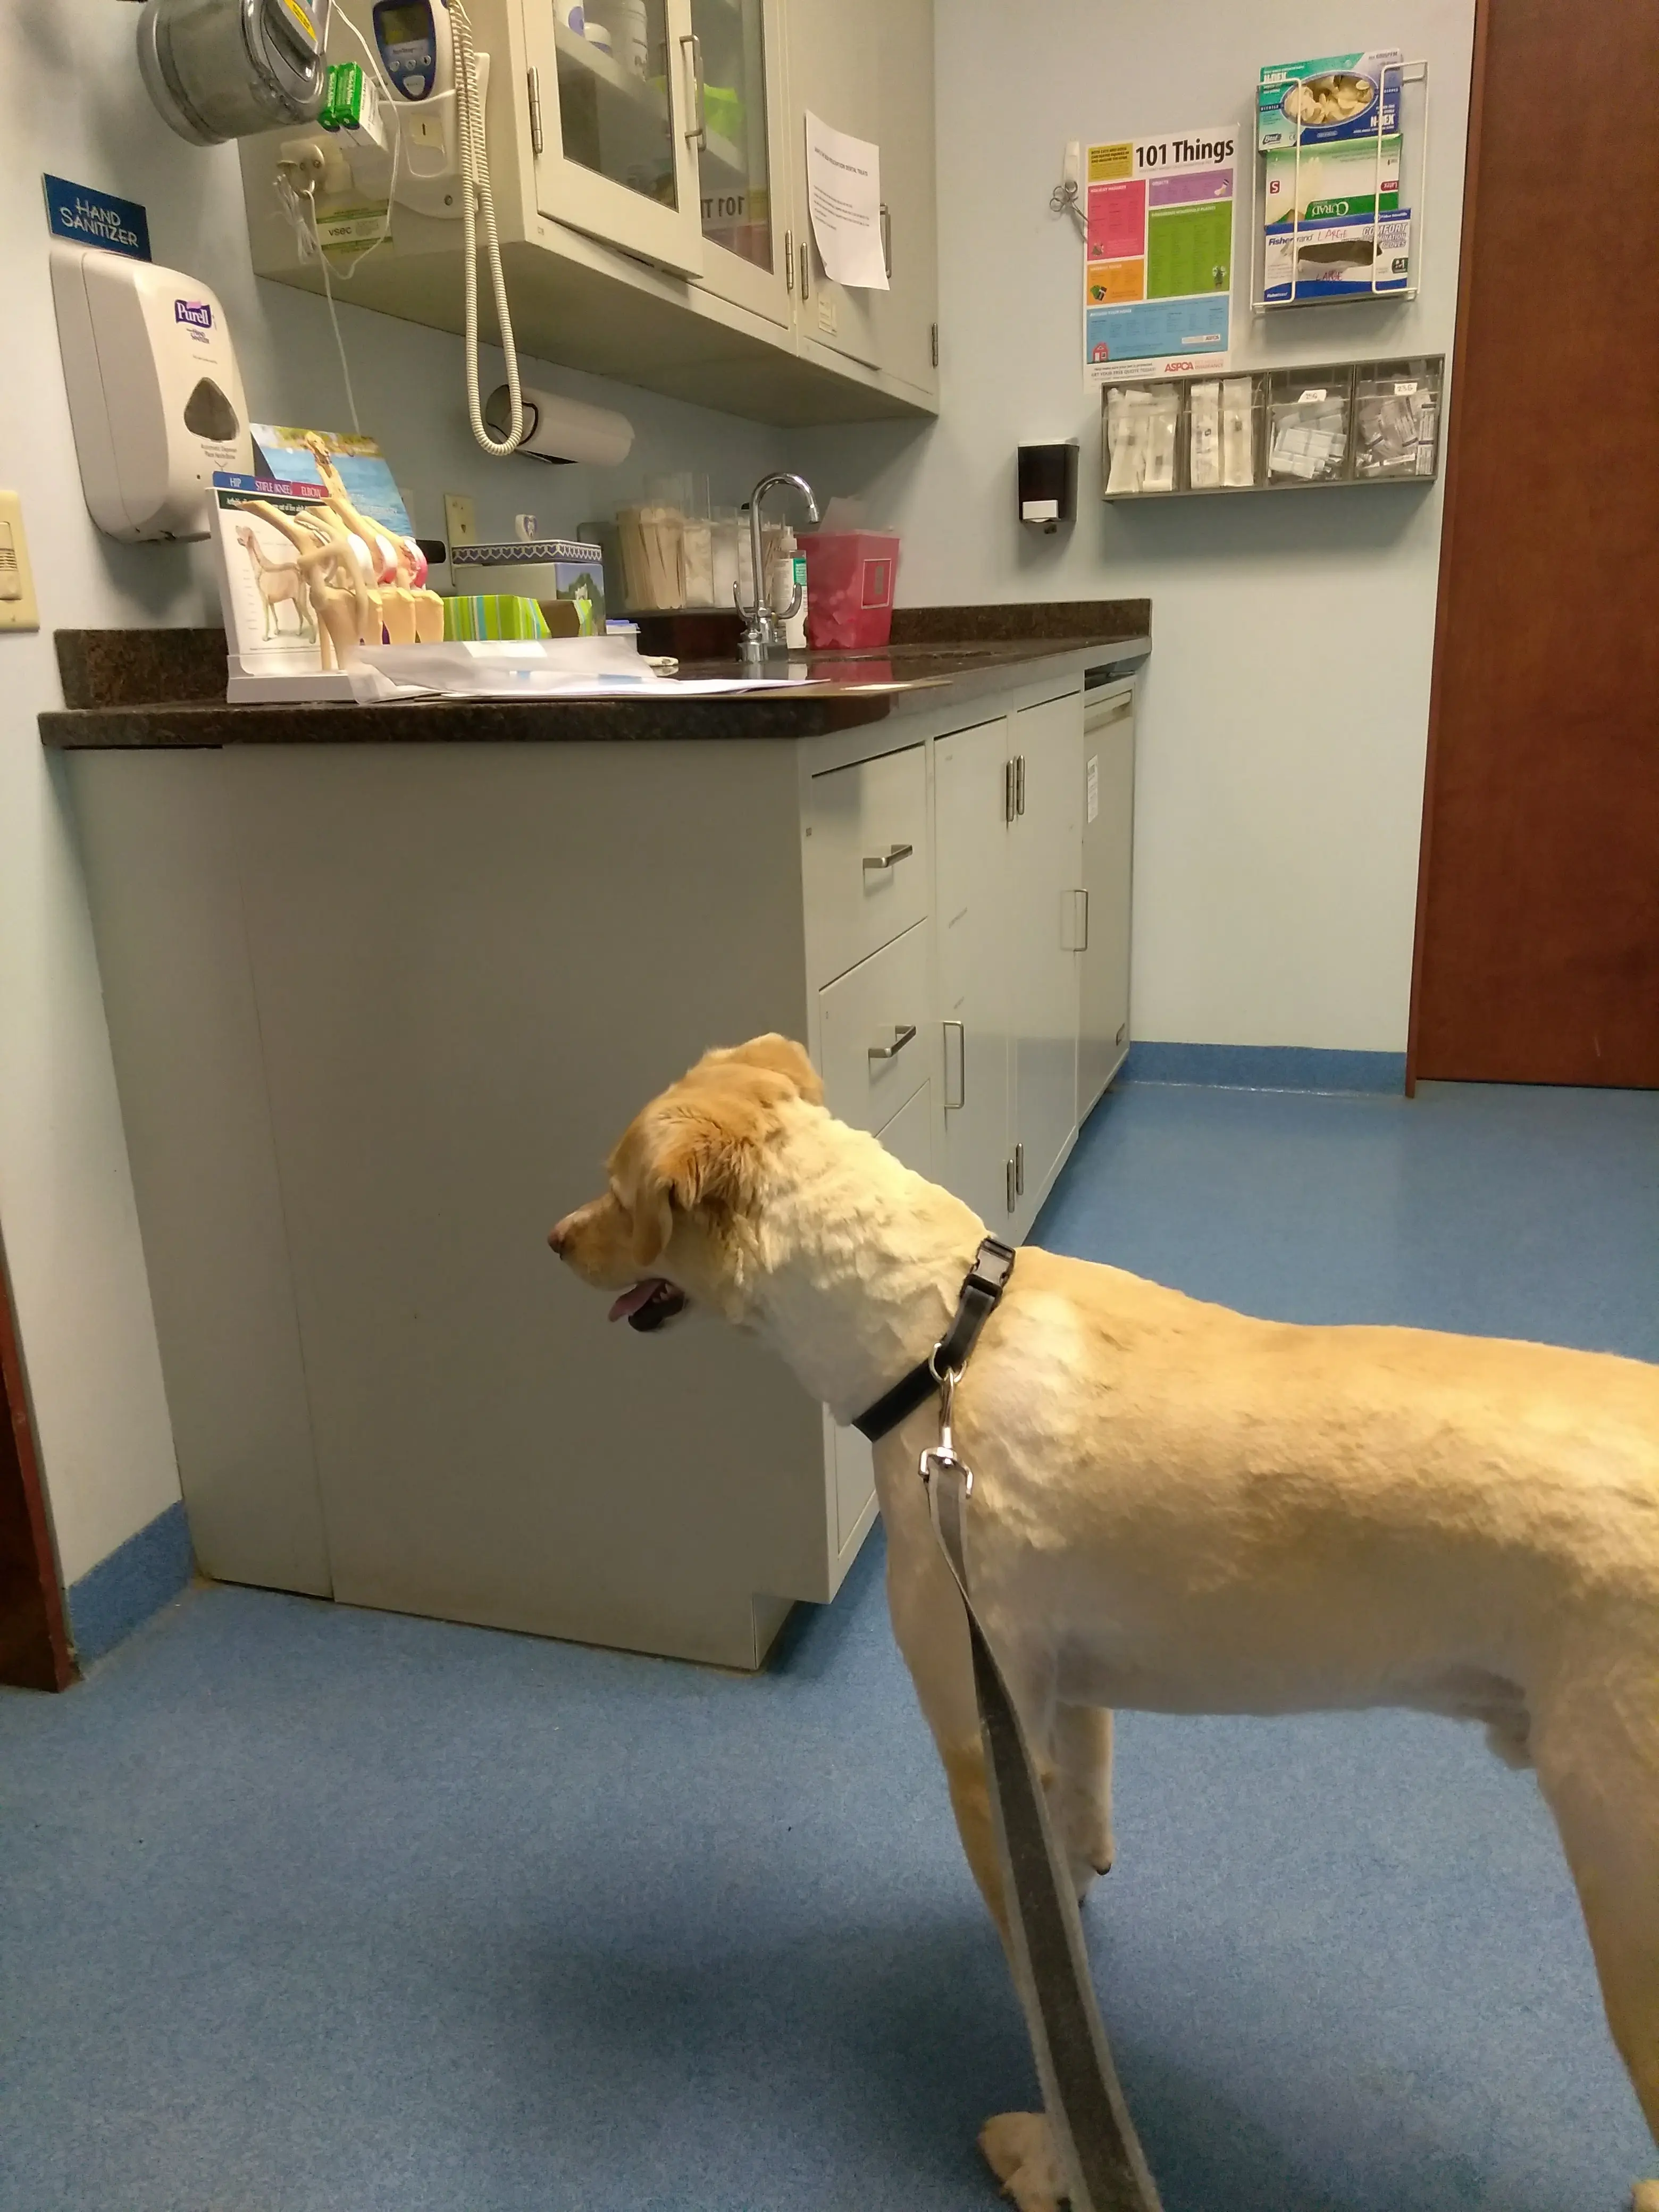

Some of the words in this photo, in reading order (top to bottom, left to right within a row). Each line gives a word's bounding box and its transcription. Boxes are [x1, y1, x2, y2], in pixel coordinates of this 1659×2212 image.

[1136, 144, 1167, 167] 101
[1171, 138, 1234, 164] Things
[1271, 181, 1279, 192] S
[76, 197, 121, 227] HAND
[1312, 202, 1349, 216] CURAD
[60, 207, 139, 248] SANITIZER
[1268, 234, 1313, 246] Fisherrand
[1318, 229, 1348, 241] LARGE
[1316, 270, 1343, 281] LARGE
[177, 302, 210, 325] Purell
[1164, 362, 1194, 372] ASPCA
[229, 477, 241, 488] HIP
[301, 486, 322, 497] ELBOW
